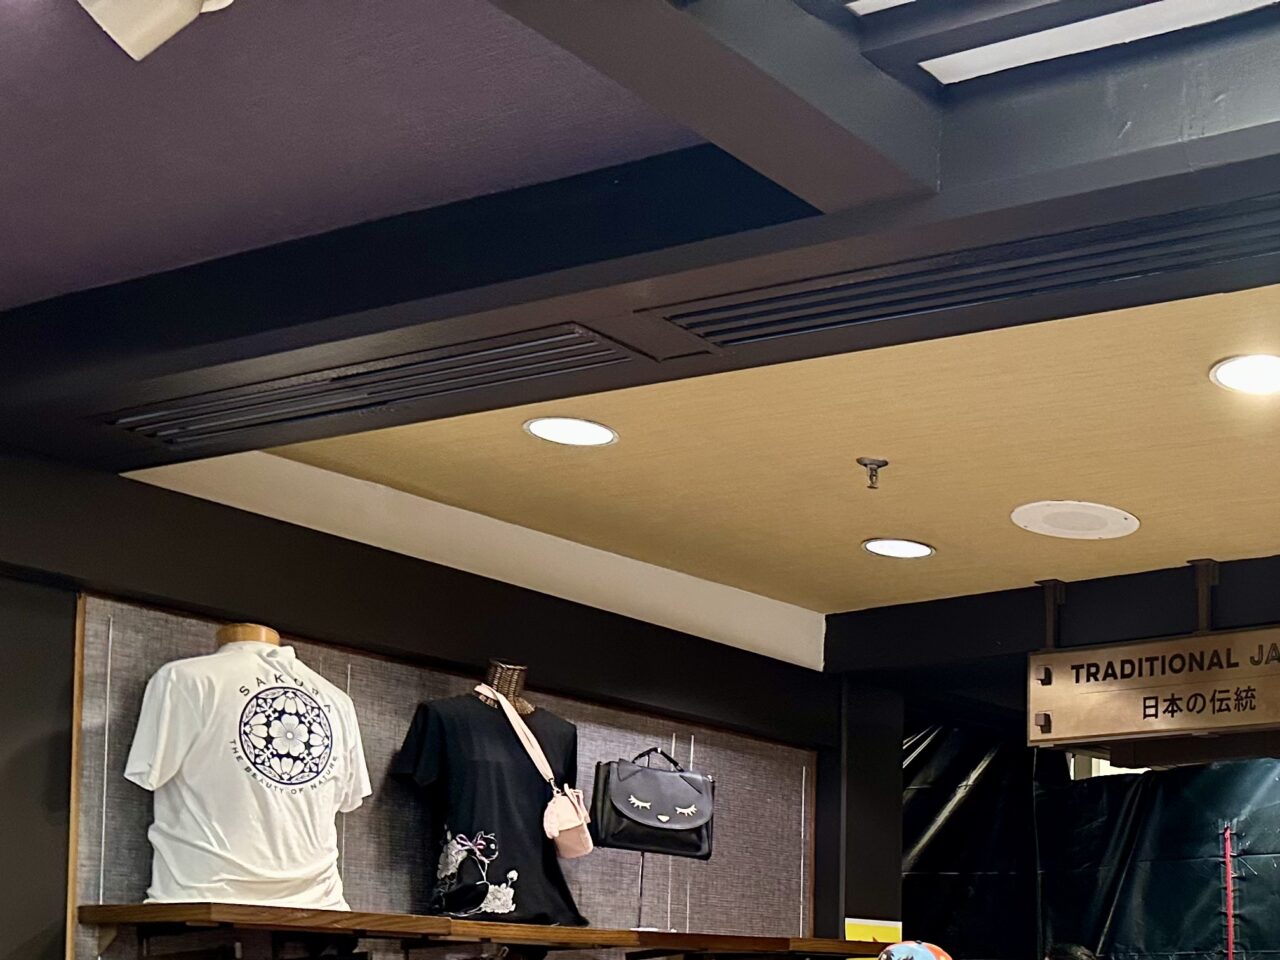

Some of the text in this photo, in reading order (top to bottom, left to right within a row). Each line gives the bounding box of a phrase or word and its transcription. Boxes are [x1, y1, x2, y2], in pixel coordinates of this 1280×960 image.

[1071, 649, 1239, 684] TRADITIONAL
[1141, 686, 1256, 720] 日本の伝統
[230, 738, 338, 795] THE BEAUTY OF NATURE
